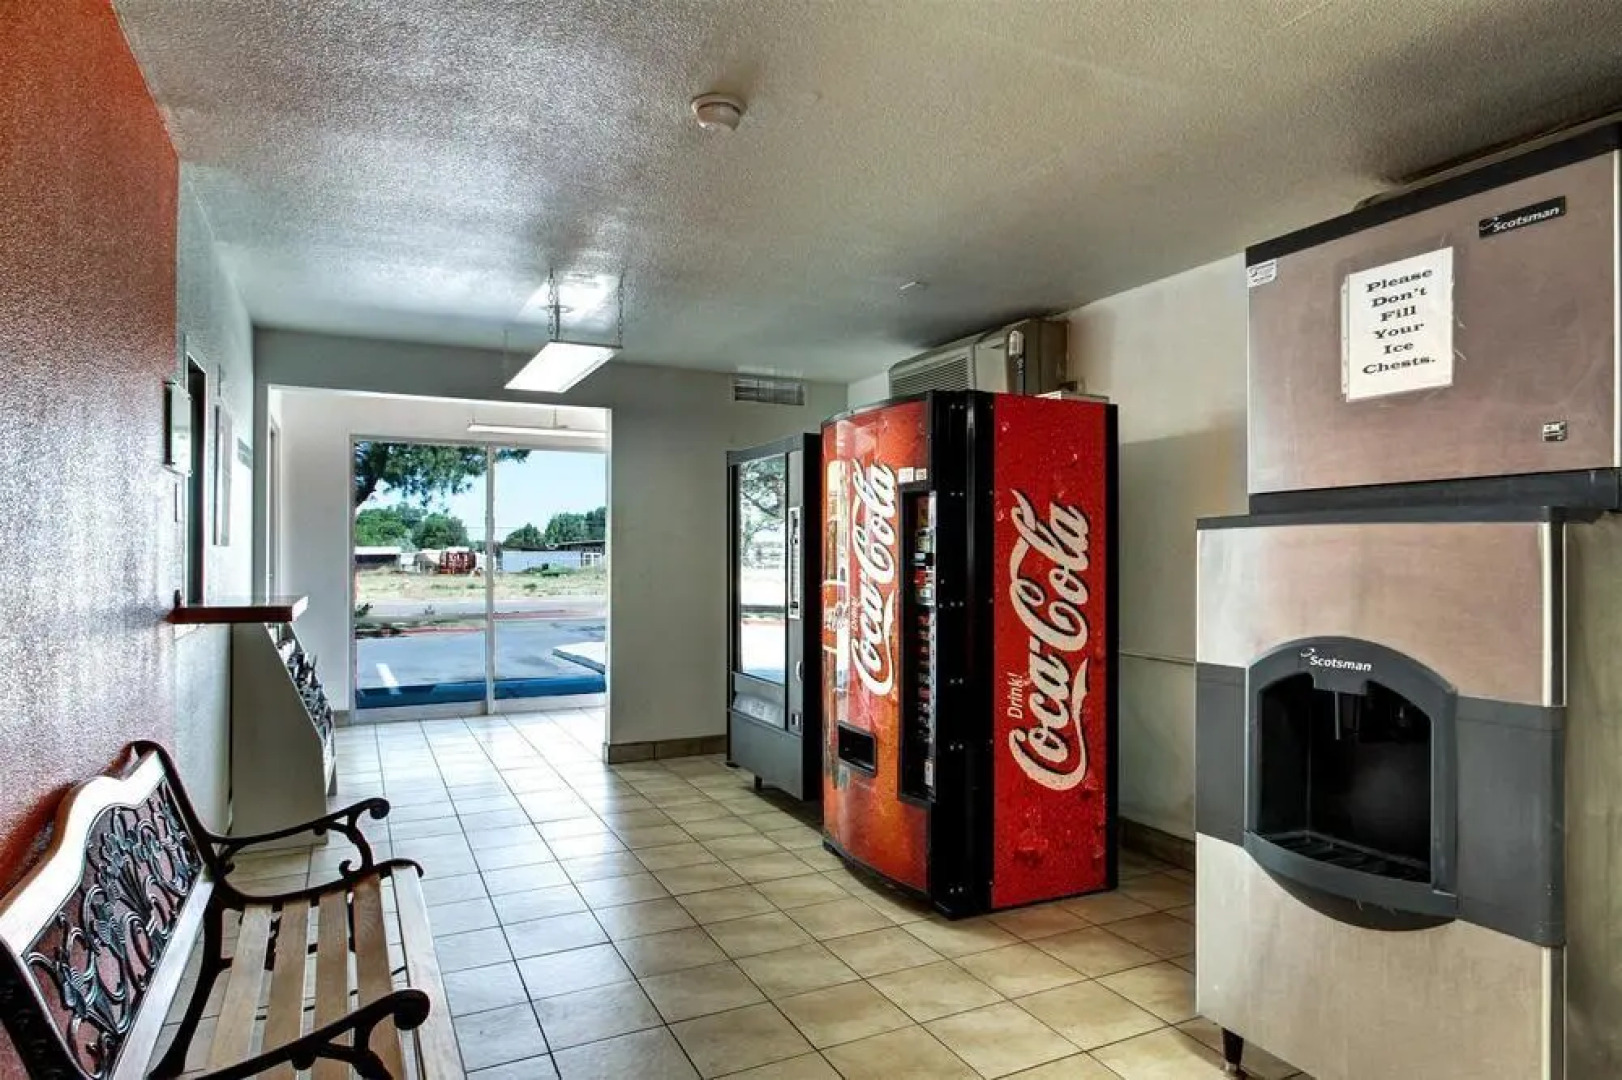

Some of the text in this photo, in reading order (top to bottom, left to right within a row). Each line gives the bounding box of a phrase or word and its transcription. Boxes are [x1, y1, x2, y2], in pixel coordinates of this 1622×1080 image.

[1493, 207, 1559, 232] Scotsman
[1366, 269, 1432, 292] Please
[1371, 287, 1427, 307] Don't
[1381, 305, 1416, 321] Fill
[1373, 323, 1425, 339] Your
[1383, 342, 1414, 355] Ice
[1362, 356, 1436, 374] Chests.
[1309, 655, 1372, 671] Scotsman
[1007, 672, 1023, 719] Drink!
